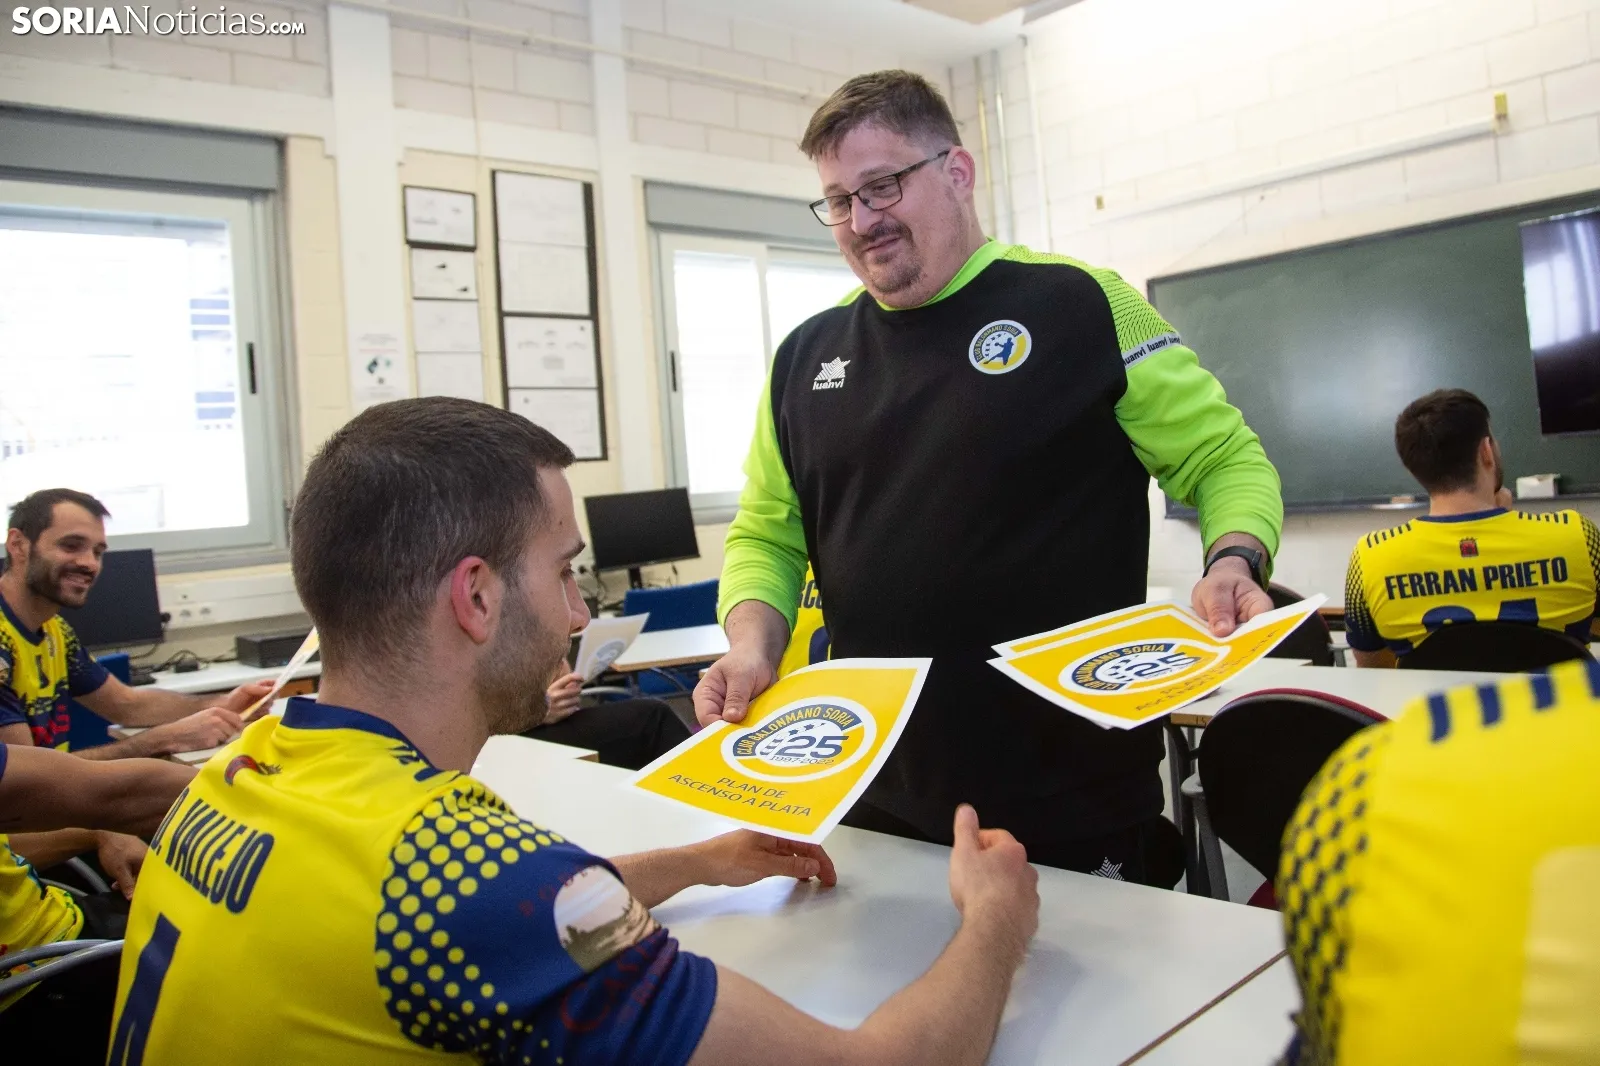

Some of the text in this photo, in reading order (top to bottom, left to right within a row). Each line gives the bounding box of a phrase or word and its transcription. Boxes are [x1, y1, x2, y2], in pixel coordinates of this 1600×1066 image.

[1147, 336, 1168, 352] luanvi
[812, 378, 845, 391] luanvi
[1384, 556, 1568, 600] FERRAN PRIETO
[1121, 644, 1165, 656] SORIA
[1124, 652, 1202, 677] 25
[736, 706, 856, 755] CLUB BALONMANO SORIA
[776, 735, 850, 759] 25
[668, 774, 811, 817] ASCENSO A PLATA
[717, 777, 788, 799] PLAN DE
[165, 798, 275, 914] VALLEJO
